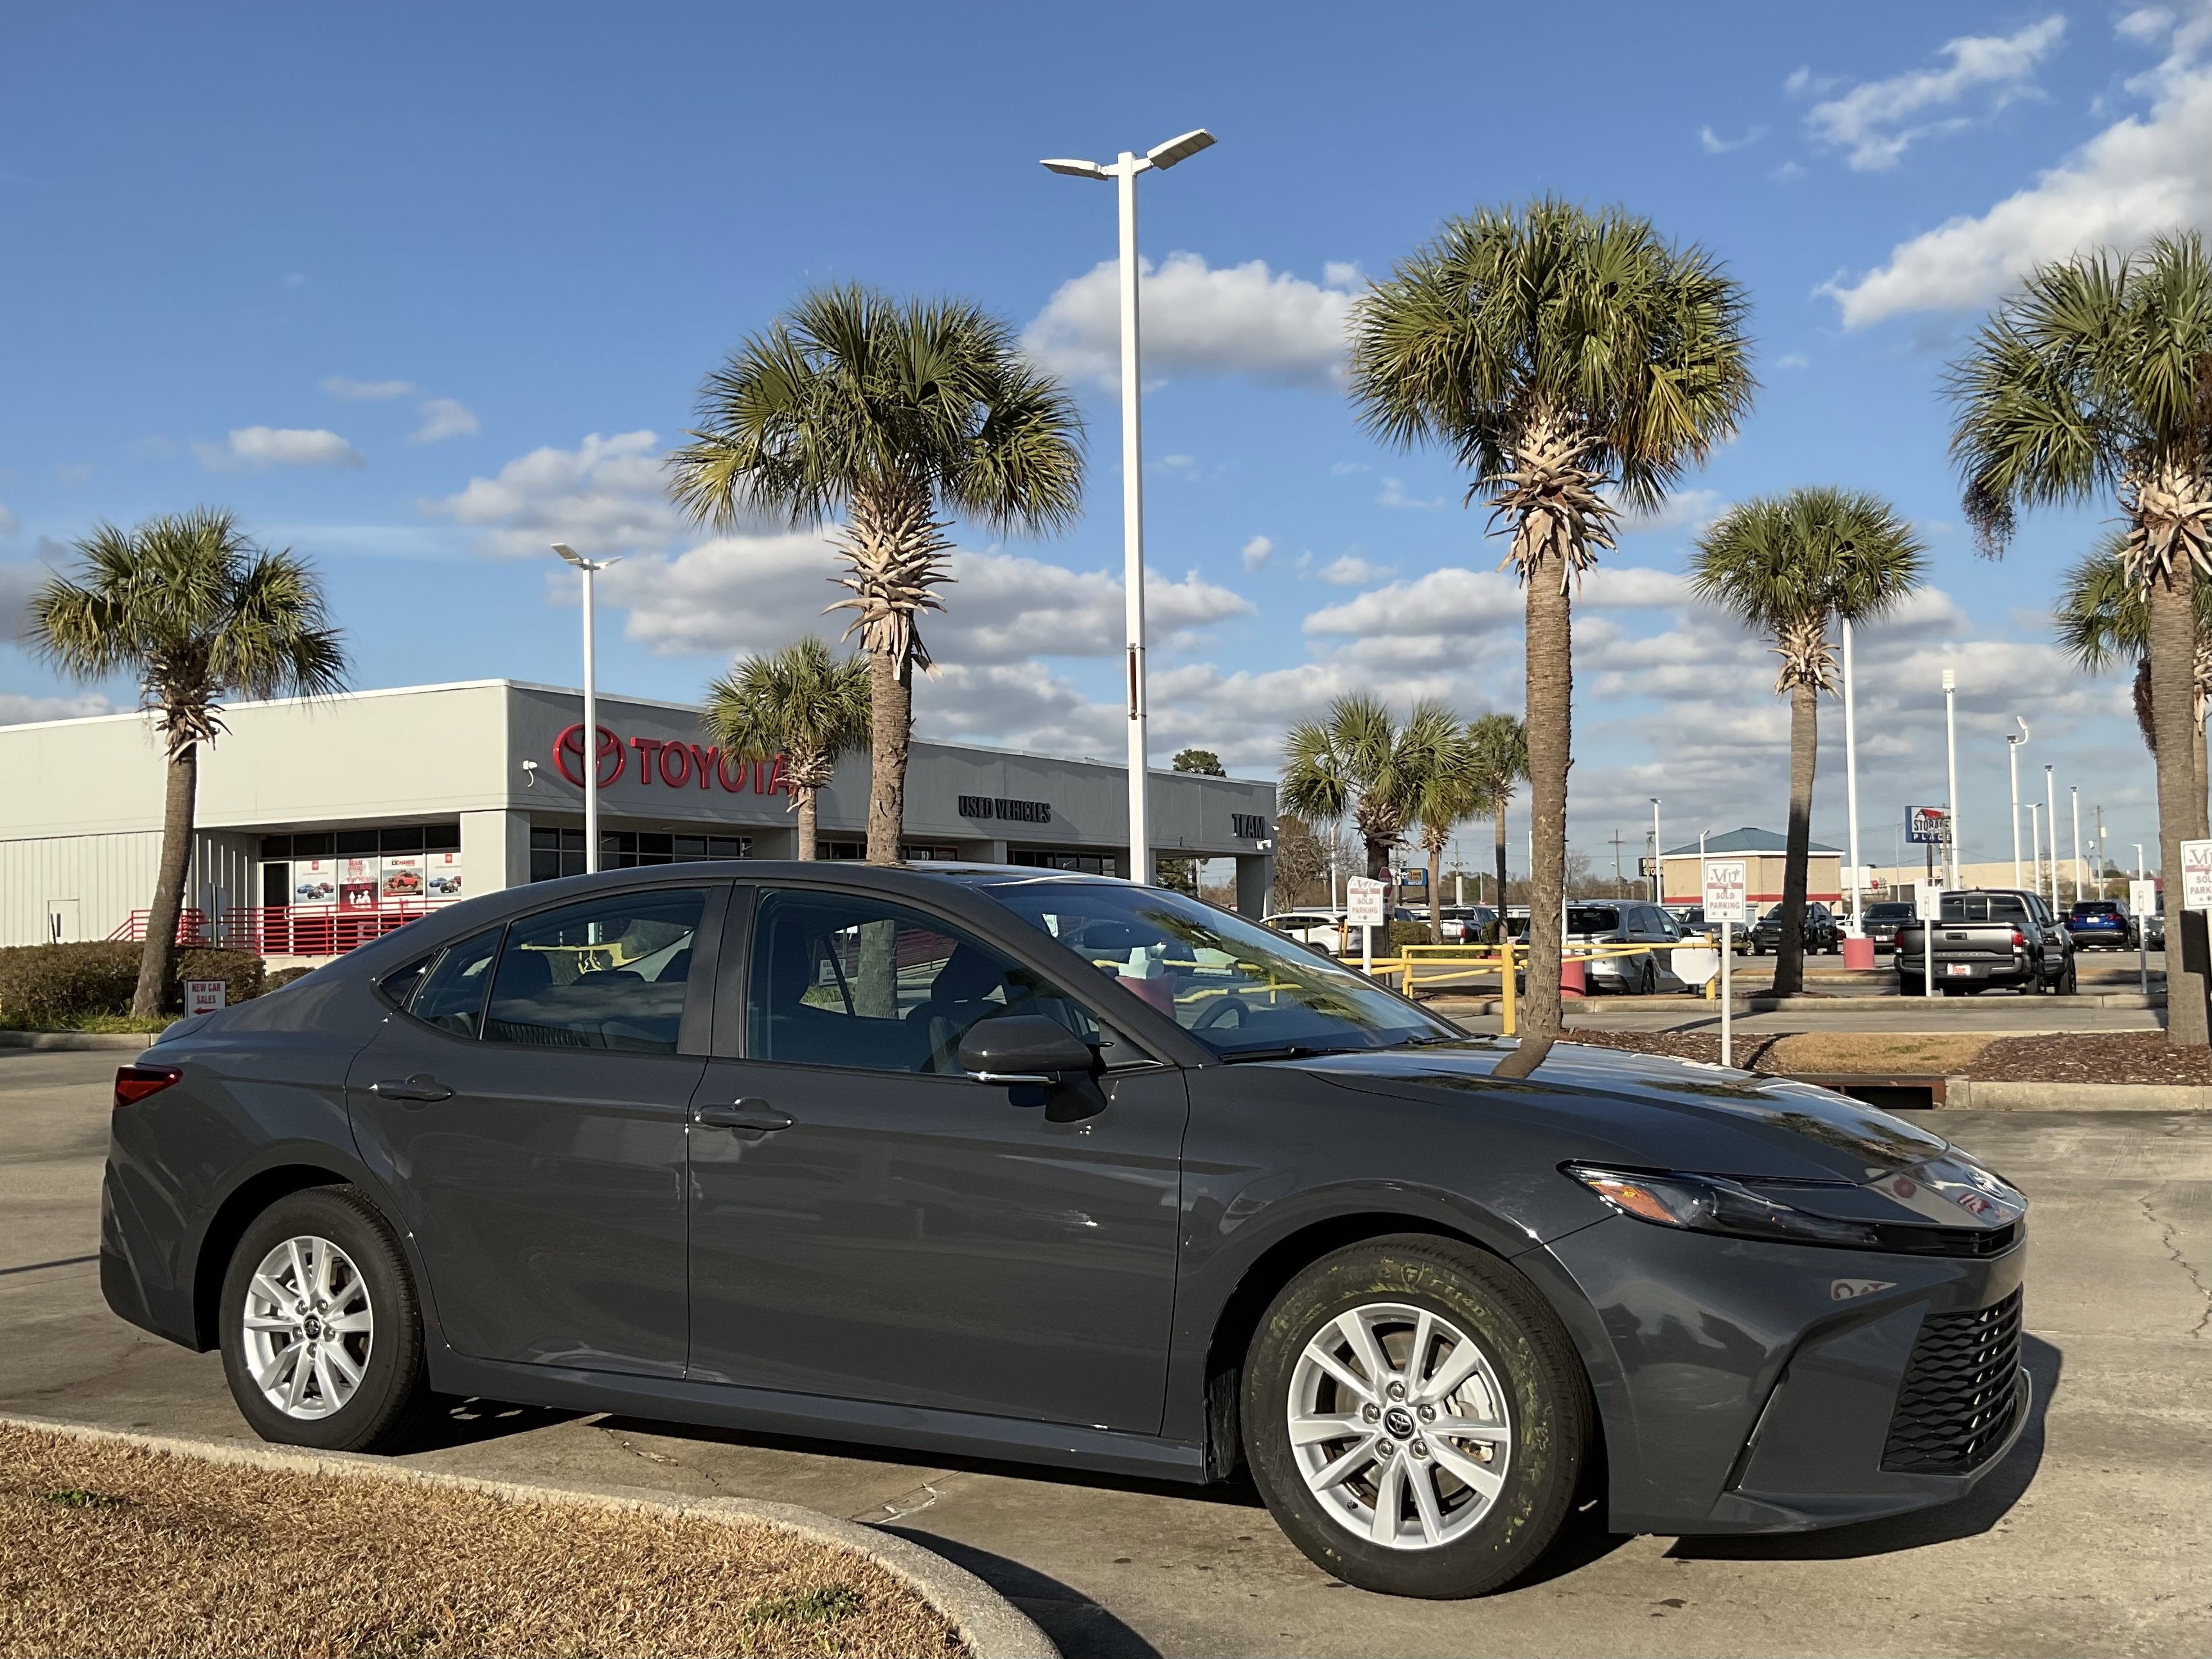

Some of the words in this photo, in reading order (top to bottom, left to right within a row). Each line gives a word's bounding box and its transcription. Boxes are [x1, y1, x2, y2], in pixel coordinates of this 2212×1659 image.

[958, 795, 994, 818] USED
[995, 798, 1051, 823] VEHICLES
[1232, 813, 1265, 838] TEAM
[1710, 901, 1740, 910] PARKING
[192, 983, 206, 992] NEW
[208, 983, 221, 992] CAR
[197, 995, 217, 1004] SALES
